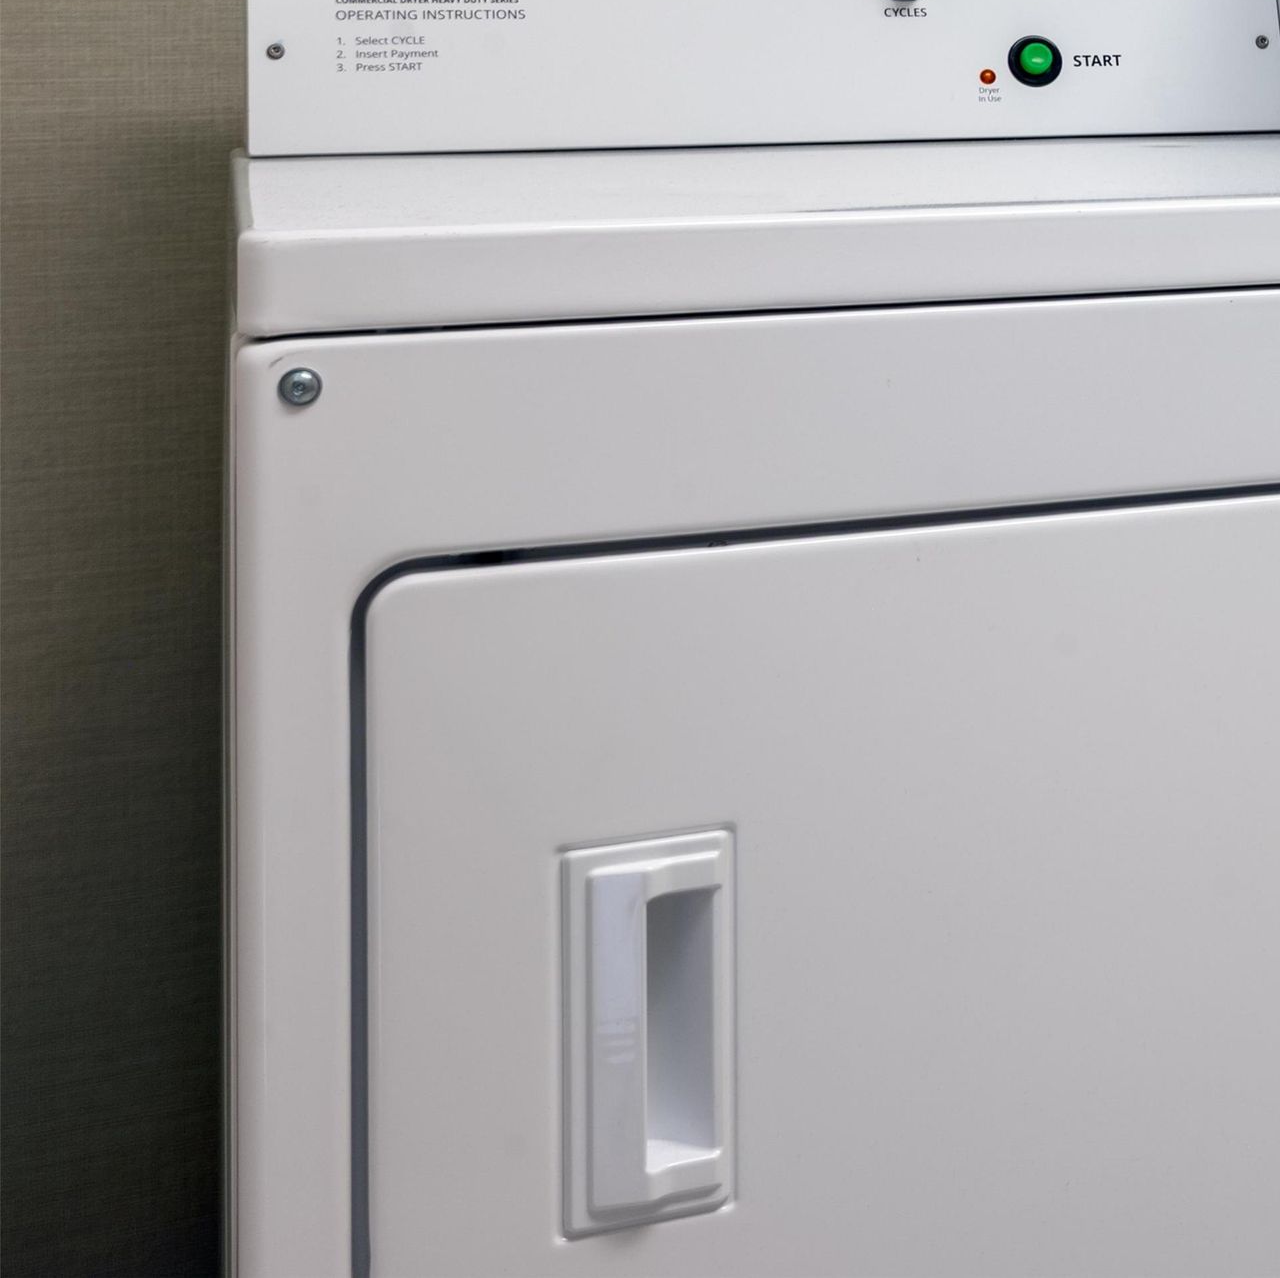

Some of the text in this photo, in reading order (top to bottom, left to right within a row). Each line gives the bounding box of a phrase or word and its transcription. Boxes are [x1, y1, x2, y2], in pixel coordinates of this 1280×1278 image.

[335, 9, 526, 21] OPERATING INSTRUCTIONS
[884, 7, 927, 18] CYCLES
[336, 36, 425, 46] 1. Select CYCLE
[336, 48, 439, 60] 2. Insert Payment
[1073, 54, 1122, 67] START
[336, 62, 423, 72] 3. Press START
[979, 87, 1000, 95] Dryer
